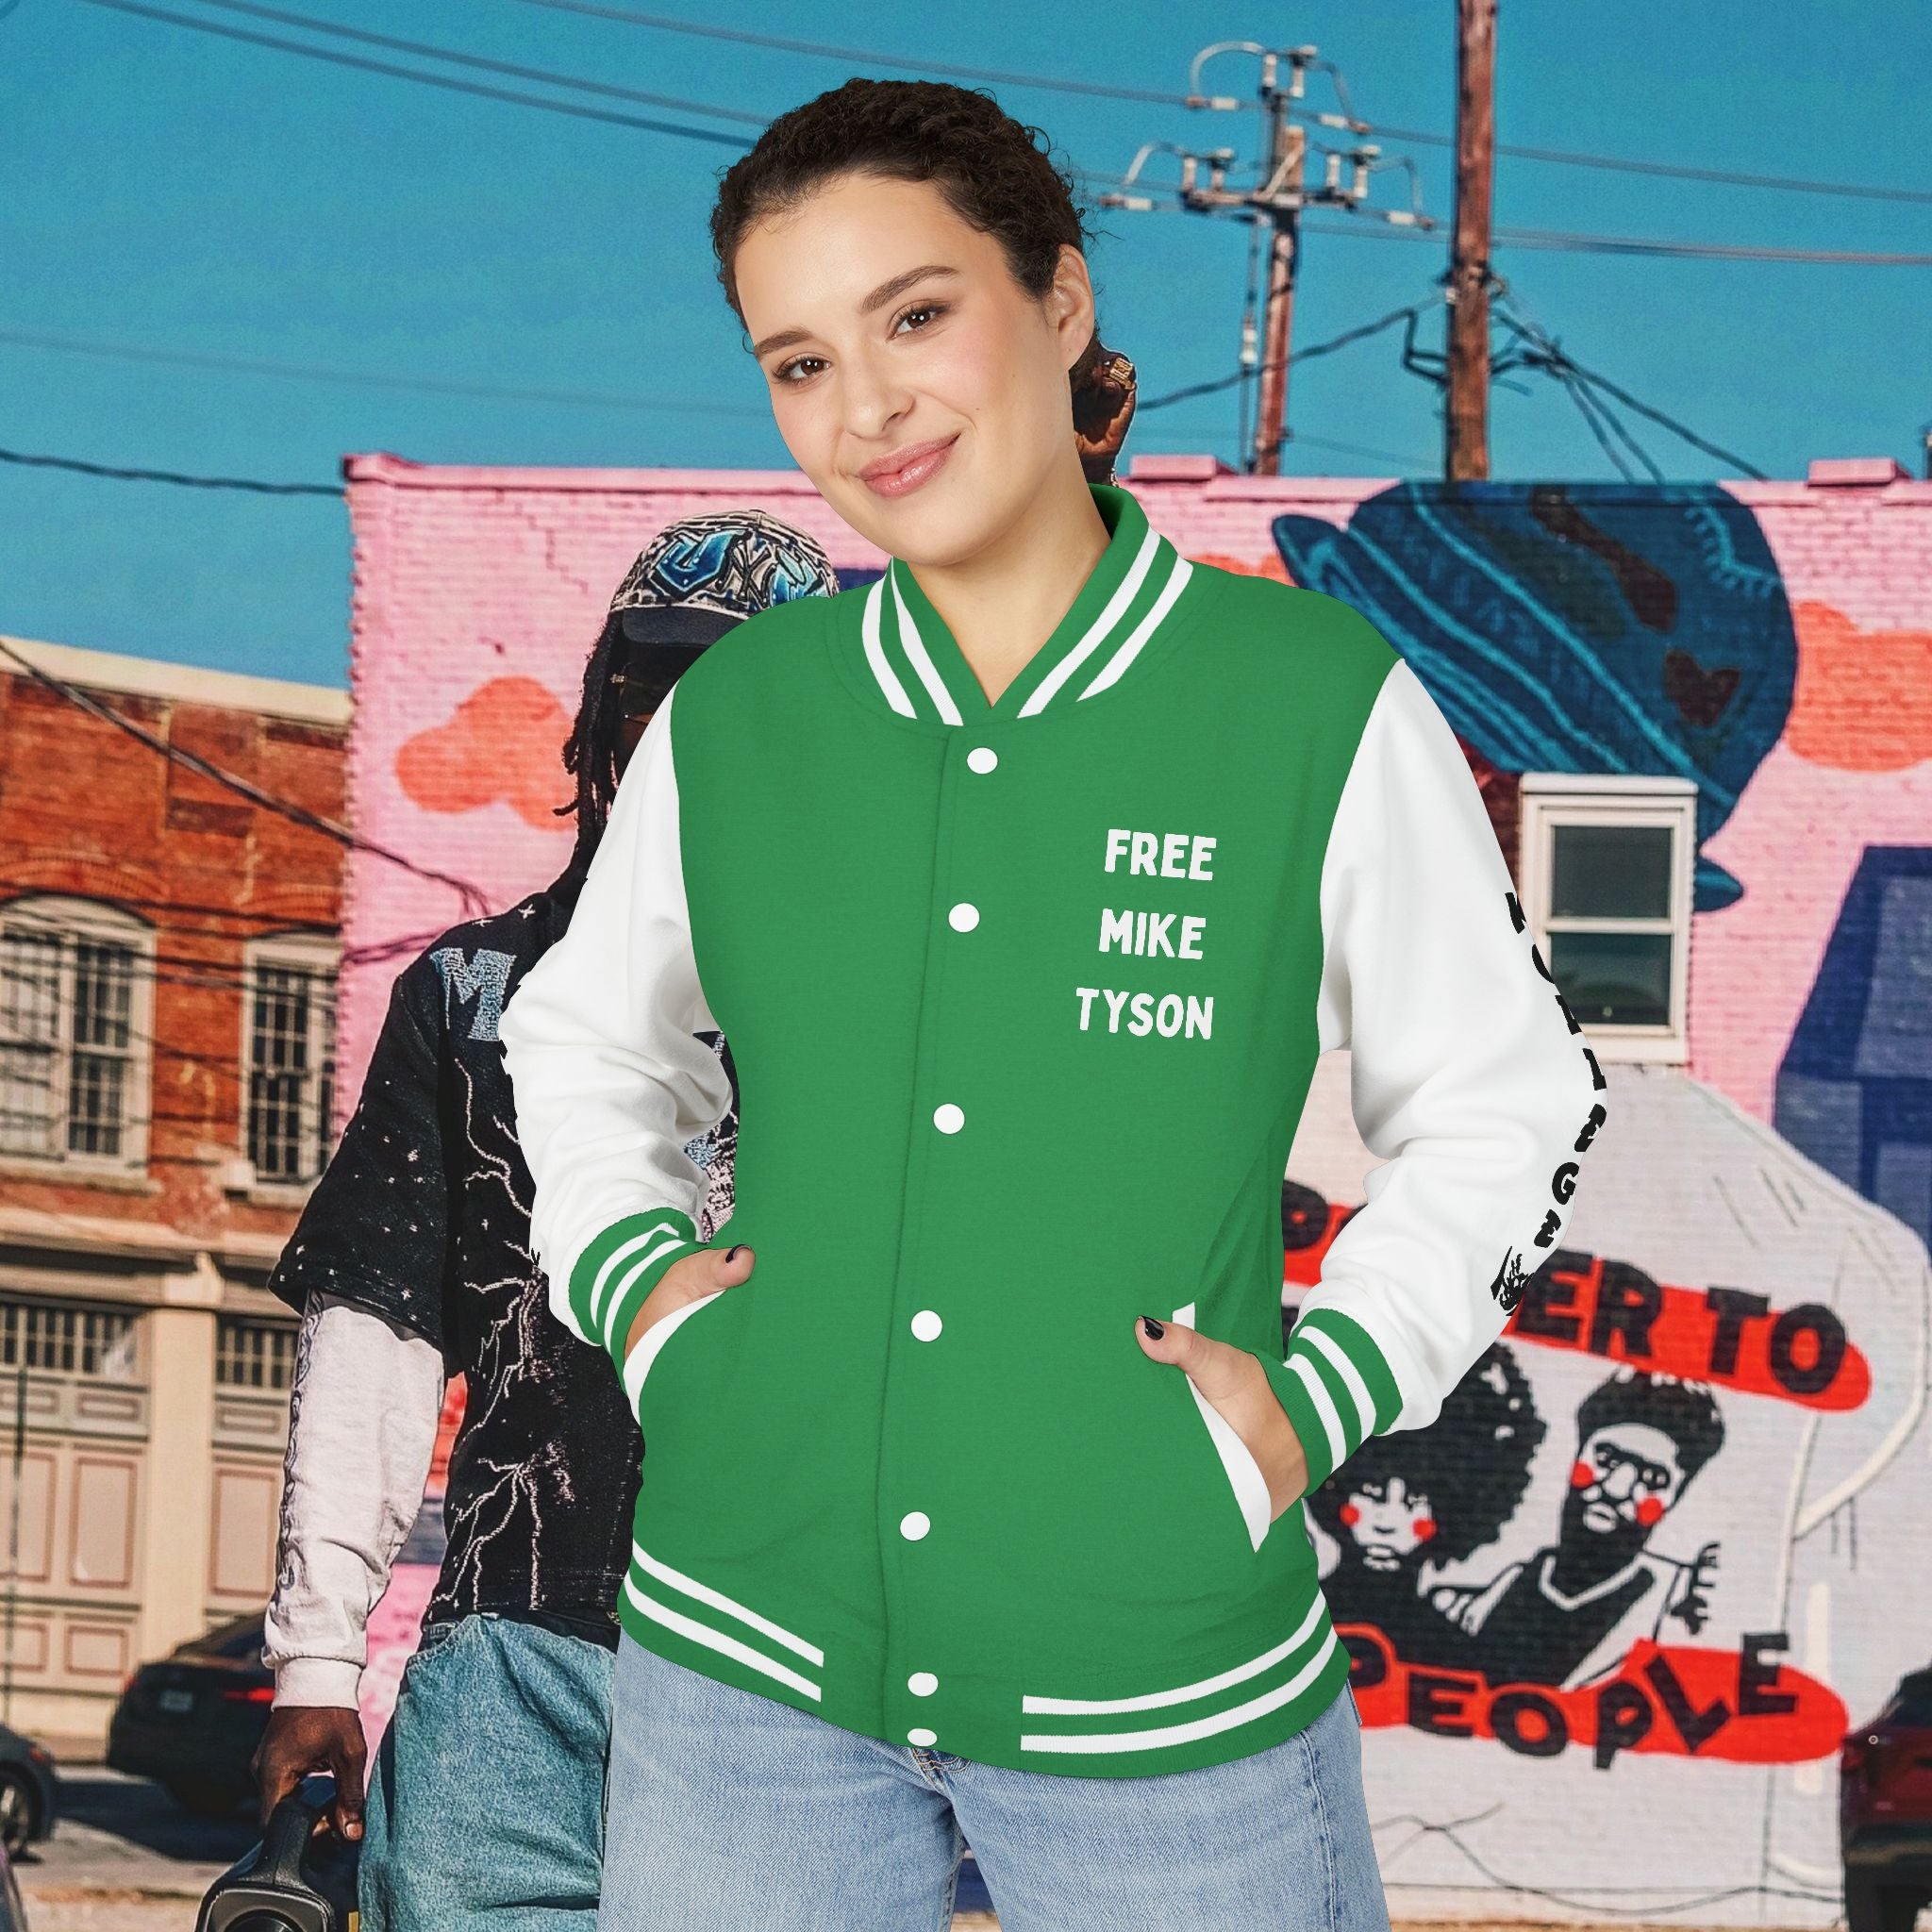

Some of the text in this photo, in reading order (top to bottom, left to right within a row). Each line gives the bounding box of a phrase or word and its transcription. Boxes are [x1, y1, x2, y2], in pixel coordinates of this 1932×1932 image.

[1104, 828, 1217, 881] FREE
[1098, 908, 1207, 960] MIKE
[1075, 987, 1214, 1041] TYSON
[1705, 1287, 1846, 1394] TO
